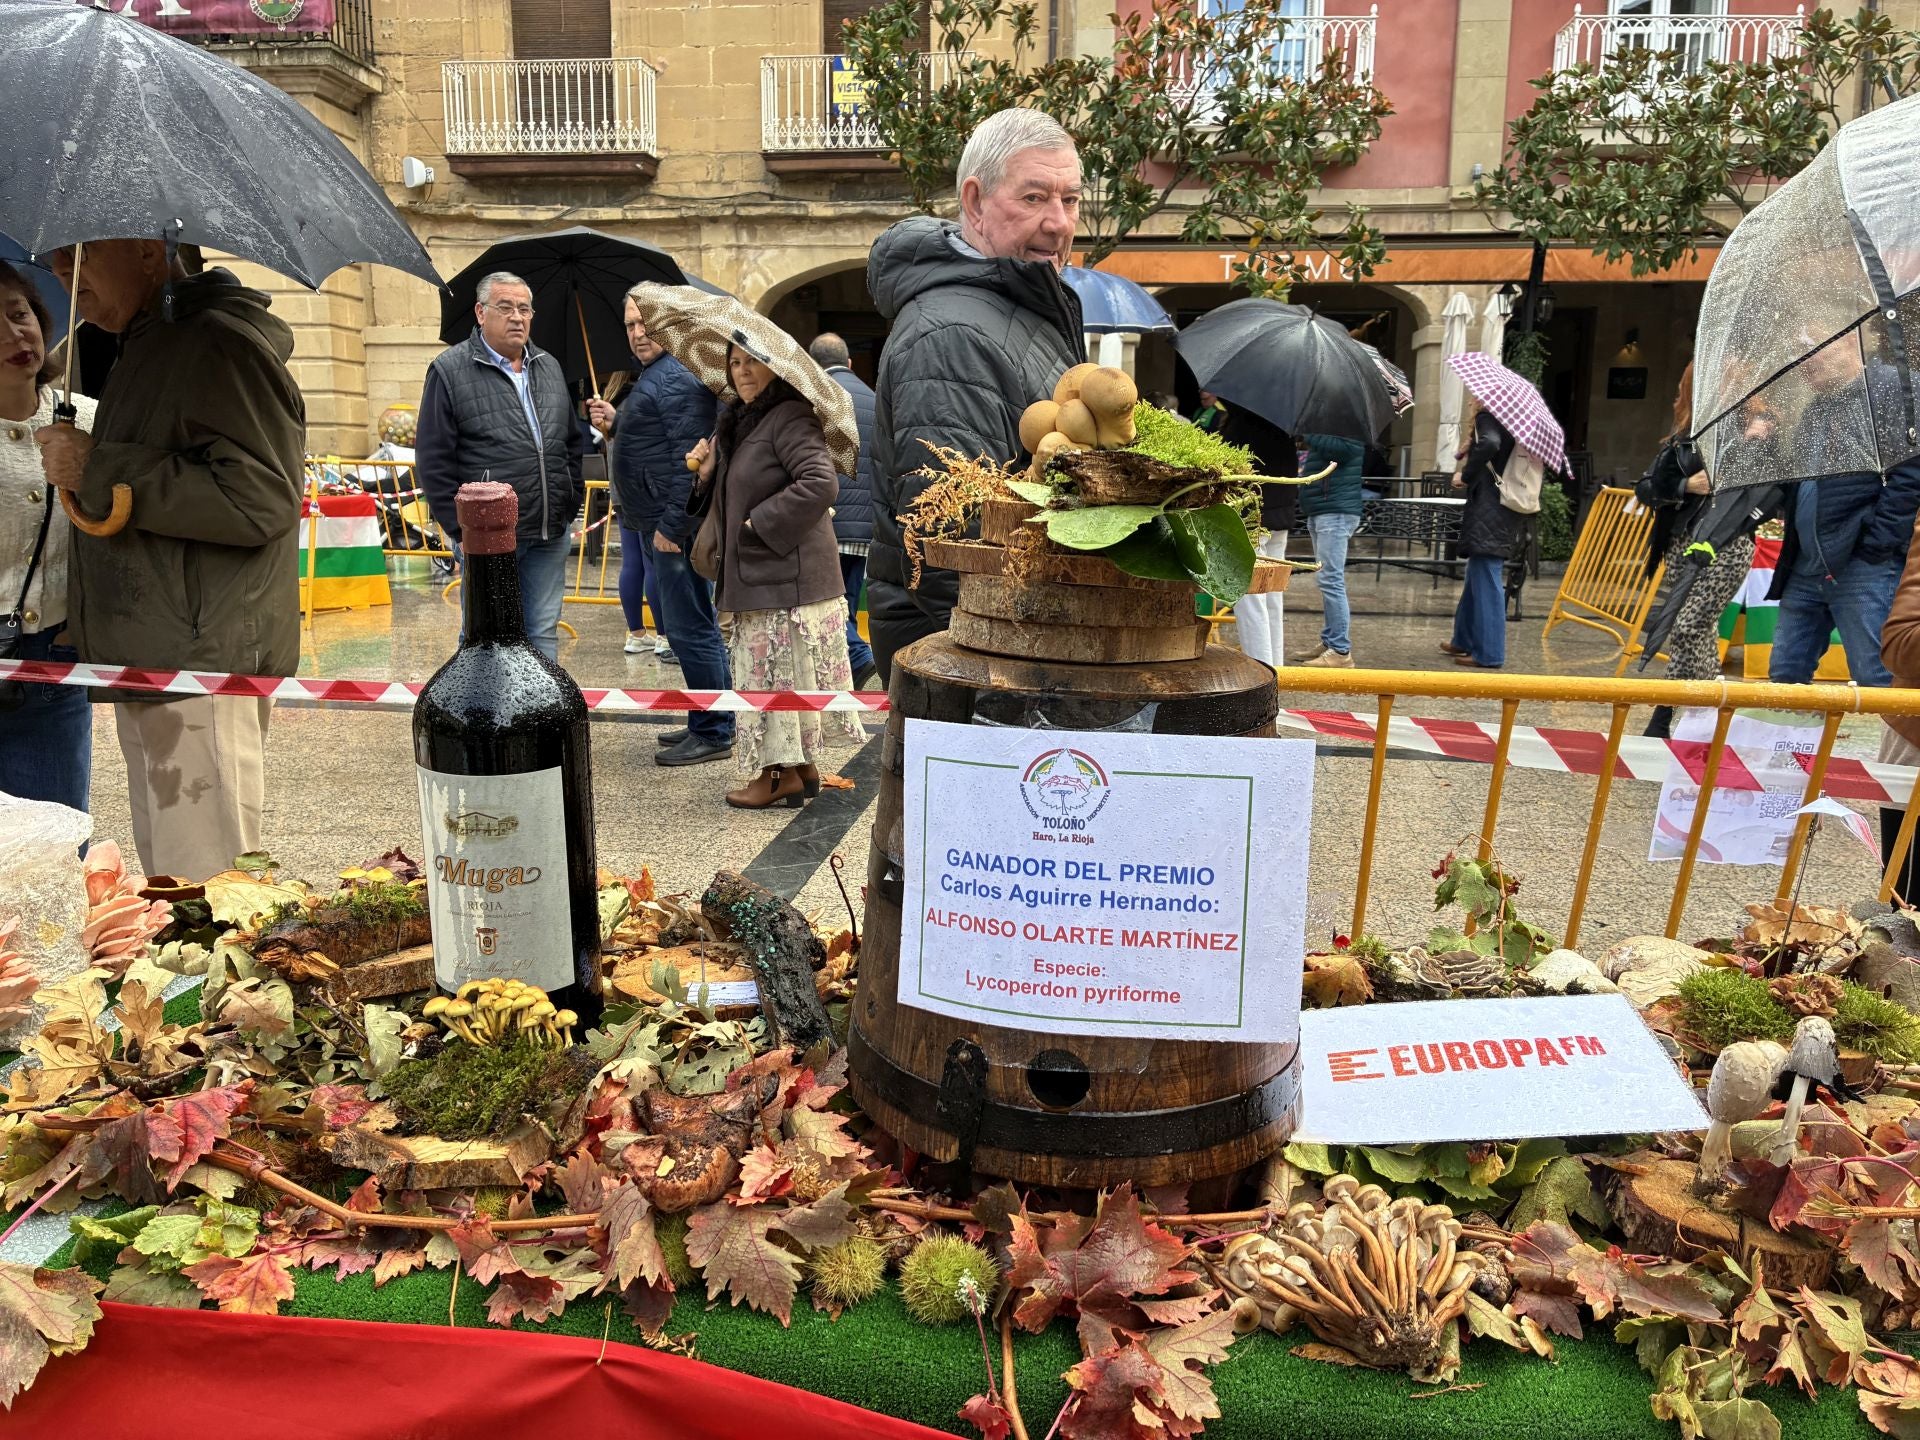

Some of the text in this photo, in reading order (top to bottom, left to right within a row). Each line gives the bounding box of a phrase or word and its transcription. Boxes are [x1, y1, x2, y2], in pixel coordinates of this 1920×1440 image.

[1032, 831, 1095, 846] Haro, La Rioja
[1042, 816, 1086, 830] TOLOÑO
[435, 854, 542, 894] Muga
[946, 848, 1215, 886] GANADOR DEL PREMIO
[467, 901, 503, 911] RIOJA
[940, 873, 1219, 914] Carlos Aguirre Hernando:
[925, 907, 1239, 951] ALFONSO OLARTE MARTÍNEZ
[1033, 958, 1106, 978] Especie:
[965, 969, 1181, 1004] Lycoperdon pyriforme
